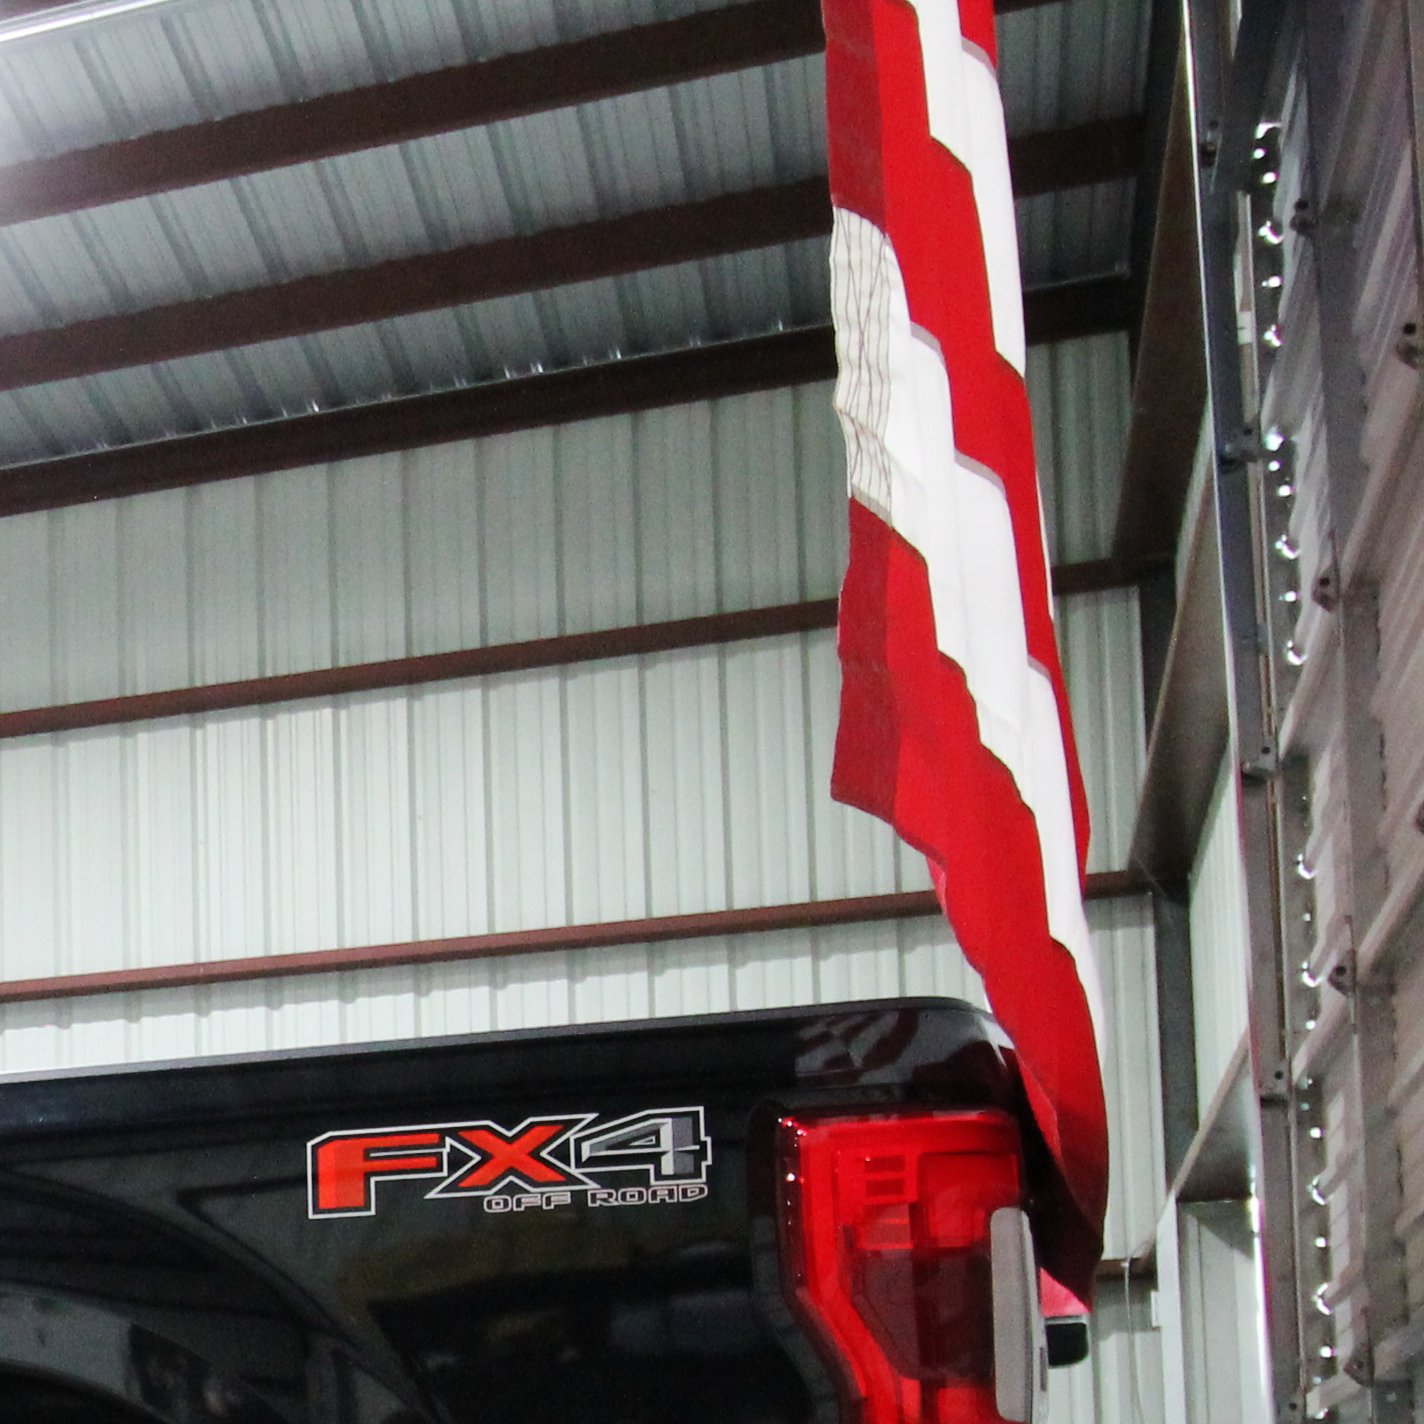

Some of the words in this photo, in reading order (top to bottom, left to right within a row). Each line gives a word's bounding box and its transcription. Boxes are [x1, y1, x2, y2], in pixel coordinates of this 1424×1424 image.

[307, 1106, 712, 1219] FX4
[483, 1195, 571, 1213] OFF
[589, 1183, 708, 1207] ROAD
